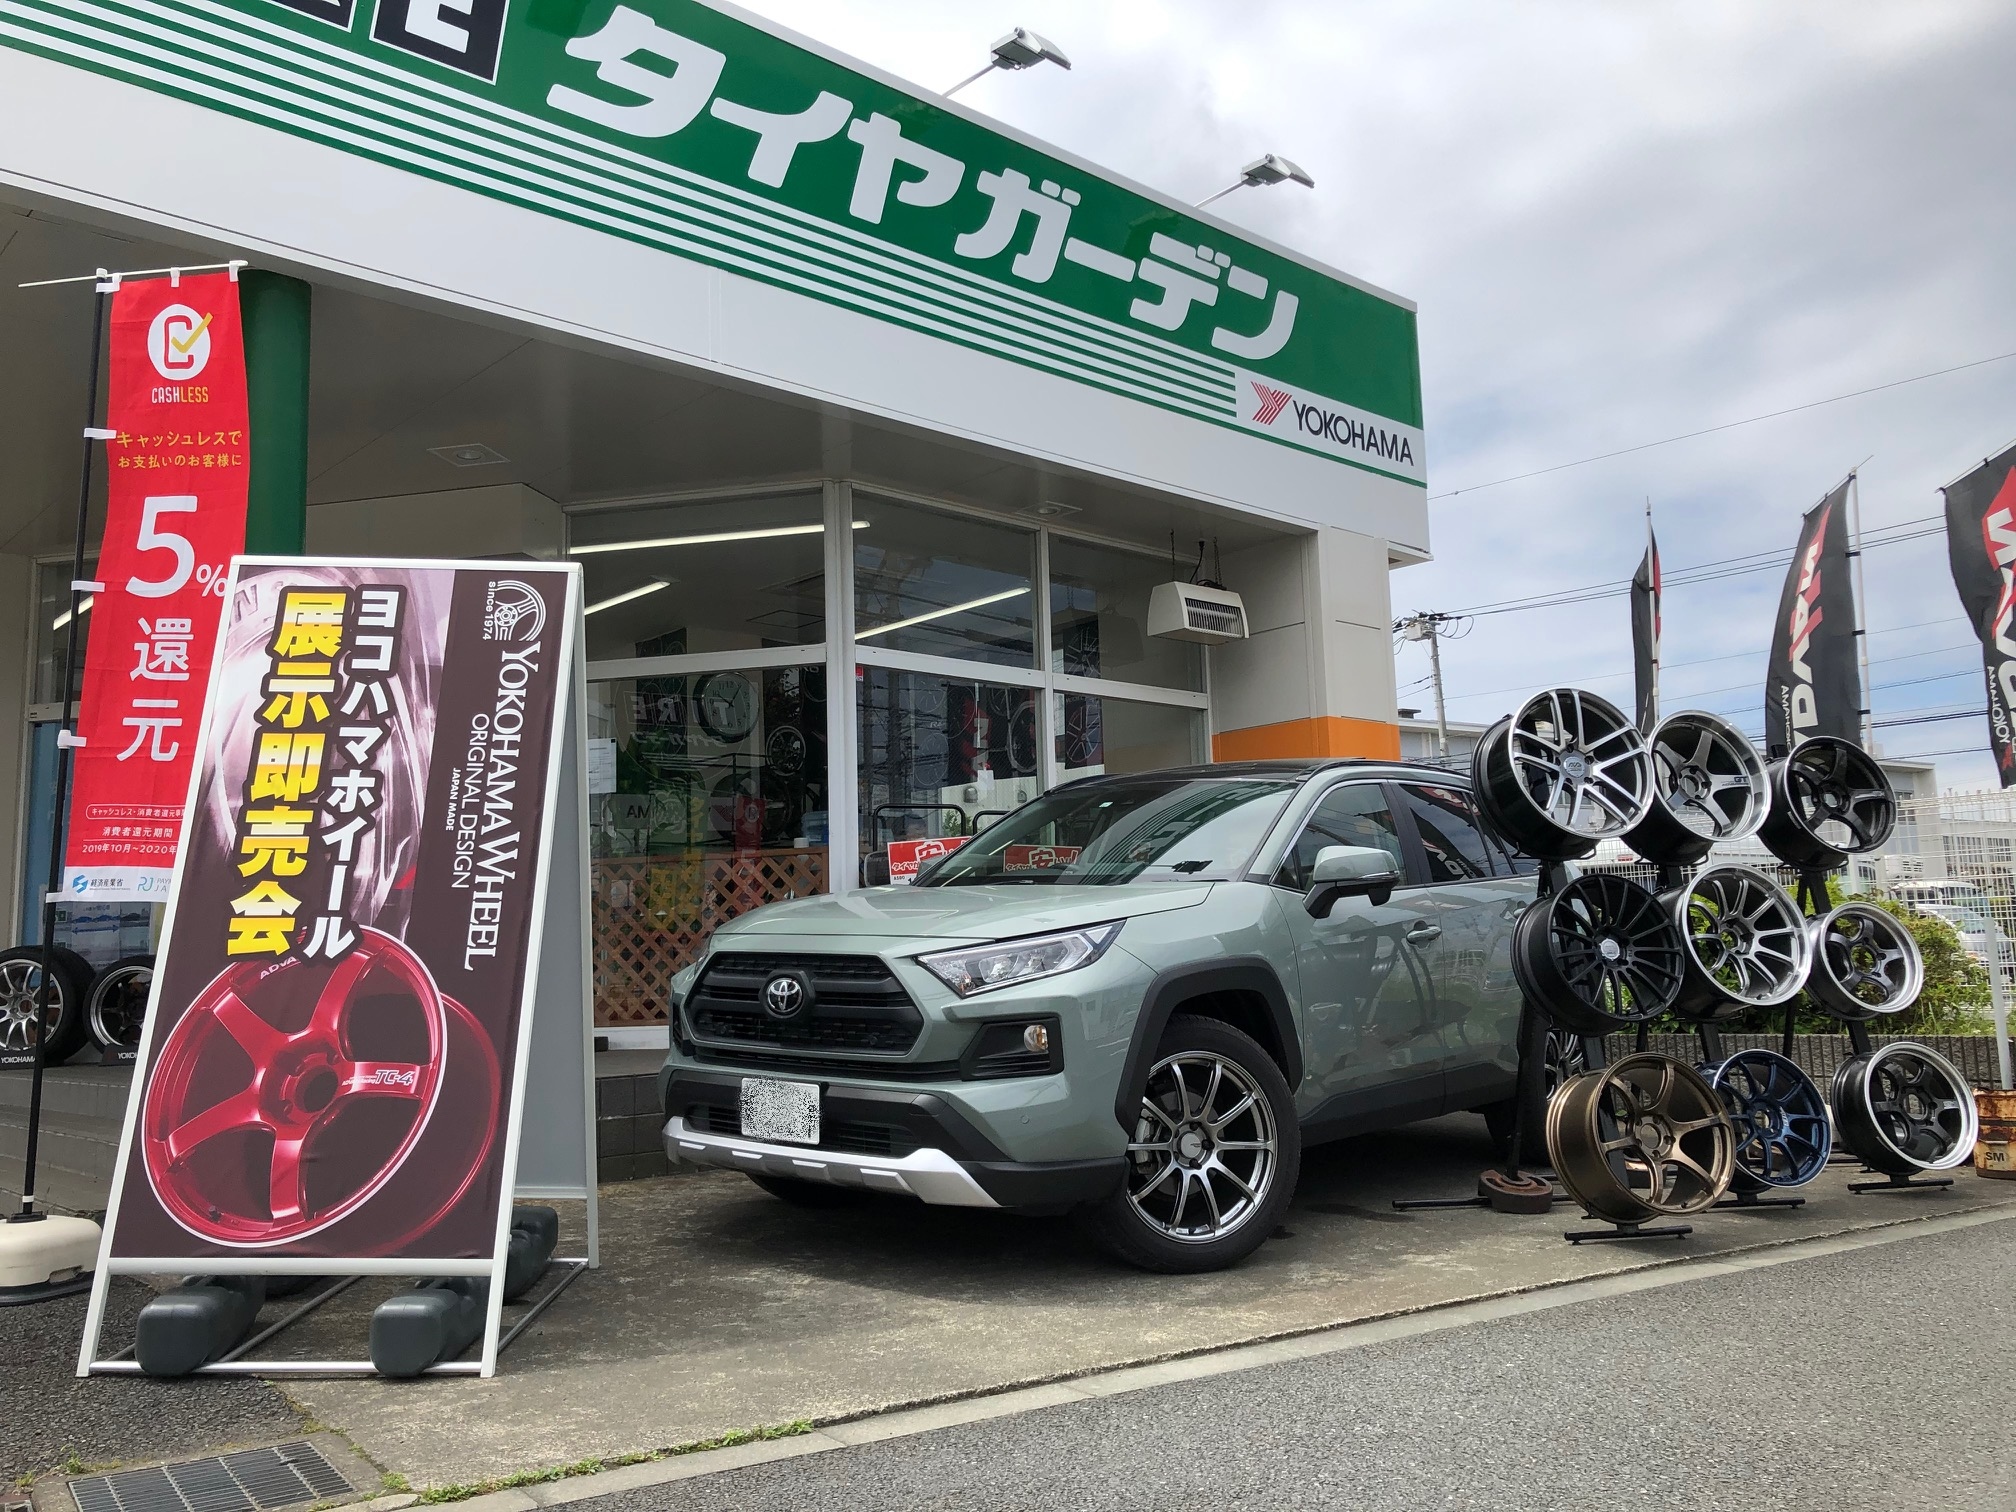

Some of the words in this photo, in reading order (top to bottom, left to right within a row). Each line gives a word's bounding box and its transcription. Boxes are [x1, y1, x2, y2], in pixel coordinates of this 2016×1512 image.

[547, 4, 1299, 360] タイヤガーデン
[151, 386, 209, 404] CASHLESS
[116, 430, 243, 448] キャッシュレスで
[1292, 399, 1414, 467] YOKOHAMA
[117, 453, 242, 469] お支払いのお客様に
[125, 495, 228, 598] 5%
[484, 580, 497, 612] since
[481, 613, 495, 641] 1974
[116, 617, 194, 762] 還元
[480, 640, 541, 835] YOKOHAMA
[226, 591, 348, 957] 展示即売会
[302, 589, 400, 960] ヨコハマホイール
[459, 712, 490, 810] ORIGINAL
[447, 766, 462, 800] JAPAN
[102, 826, 174, 839] 消費者還元期間
[444, 801, 459, 832] MADE
[451, 813, 478, 889] DESIGN
[463, 830, 521, 971] WHEEL
[260, 956, 300, 980] ADVA
[374, 1069, 416, 1087] TC-4
[1985, 1151, 2005, 1162] SM
